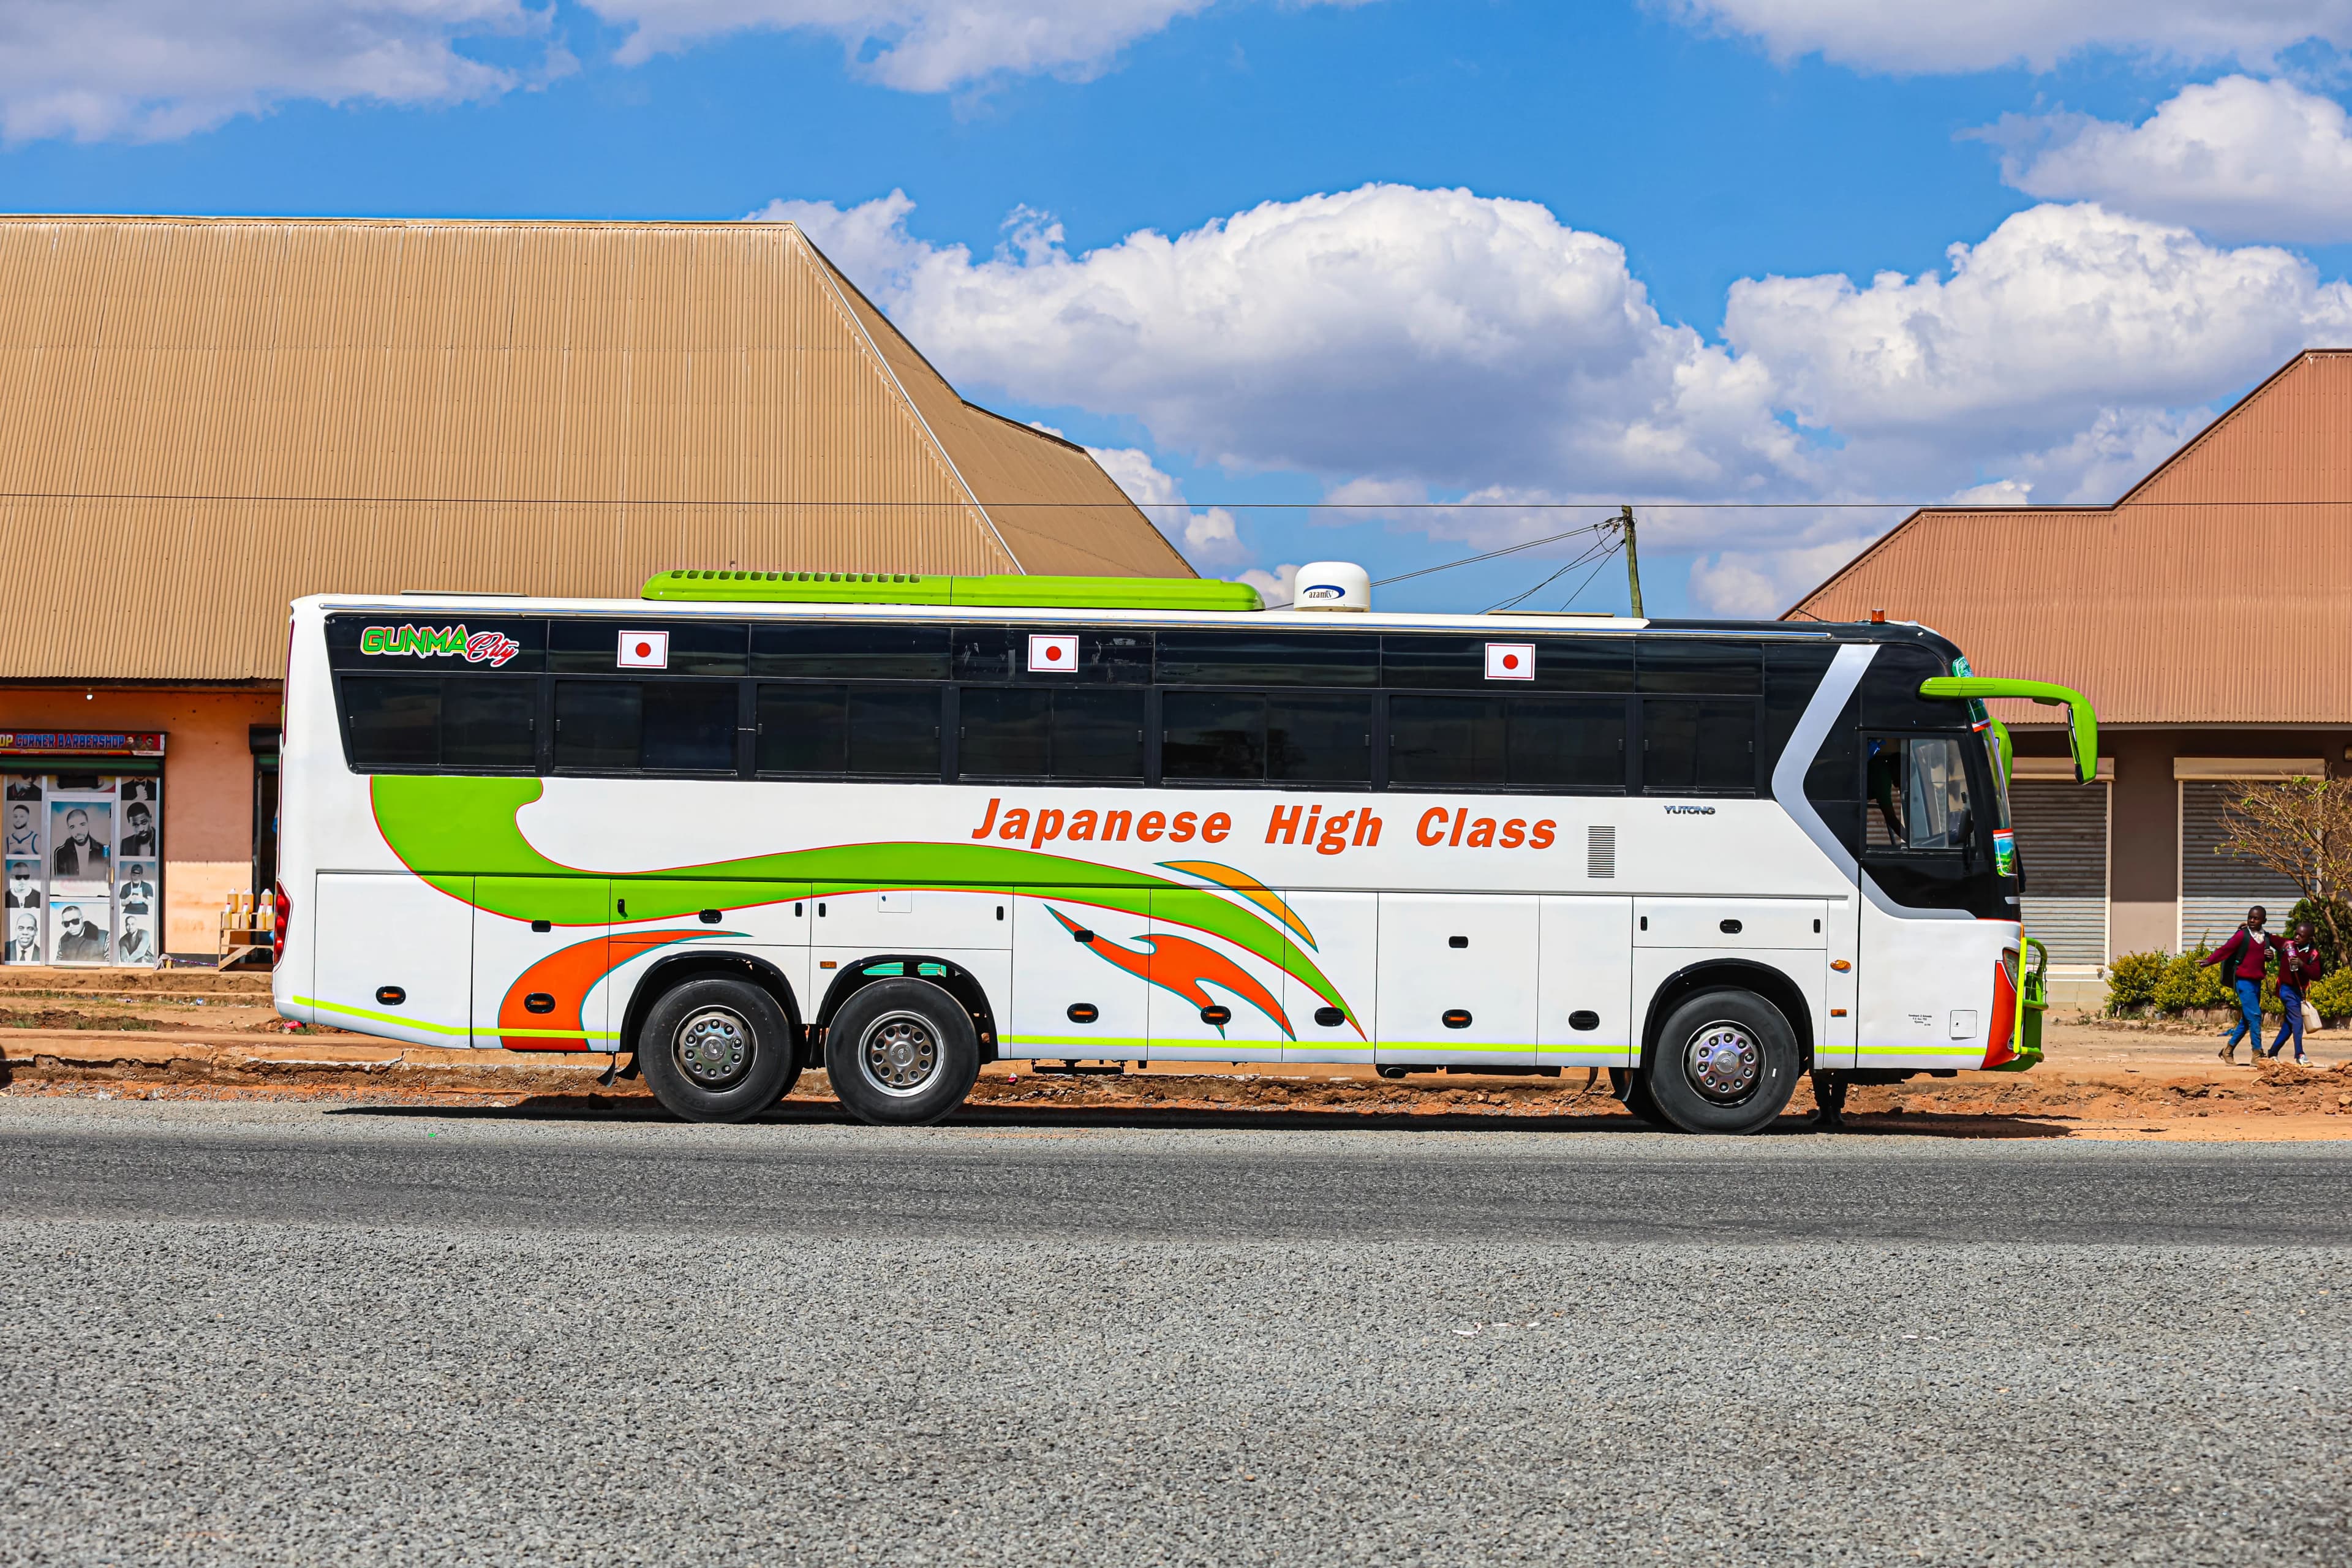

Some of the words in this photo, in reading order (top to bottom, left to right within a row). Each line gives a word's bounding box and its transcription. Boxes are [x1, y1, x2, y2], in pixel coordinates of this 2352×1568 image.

[361, 624, 469, 658] GUNMA
[466, 631, 519, 667] City
[15, 734, 56, 747] CORNER
[58, 734, 126, 748] BARBERSHOP
[1664, 805, 1716, 815] YUTONG
[972, 798, 1231, 850] Japanese
[1265, 805, 1382, 856] High
[1417, 806, 1556, 850] Class
